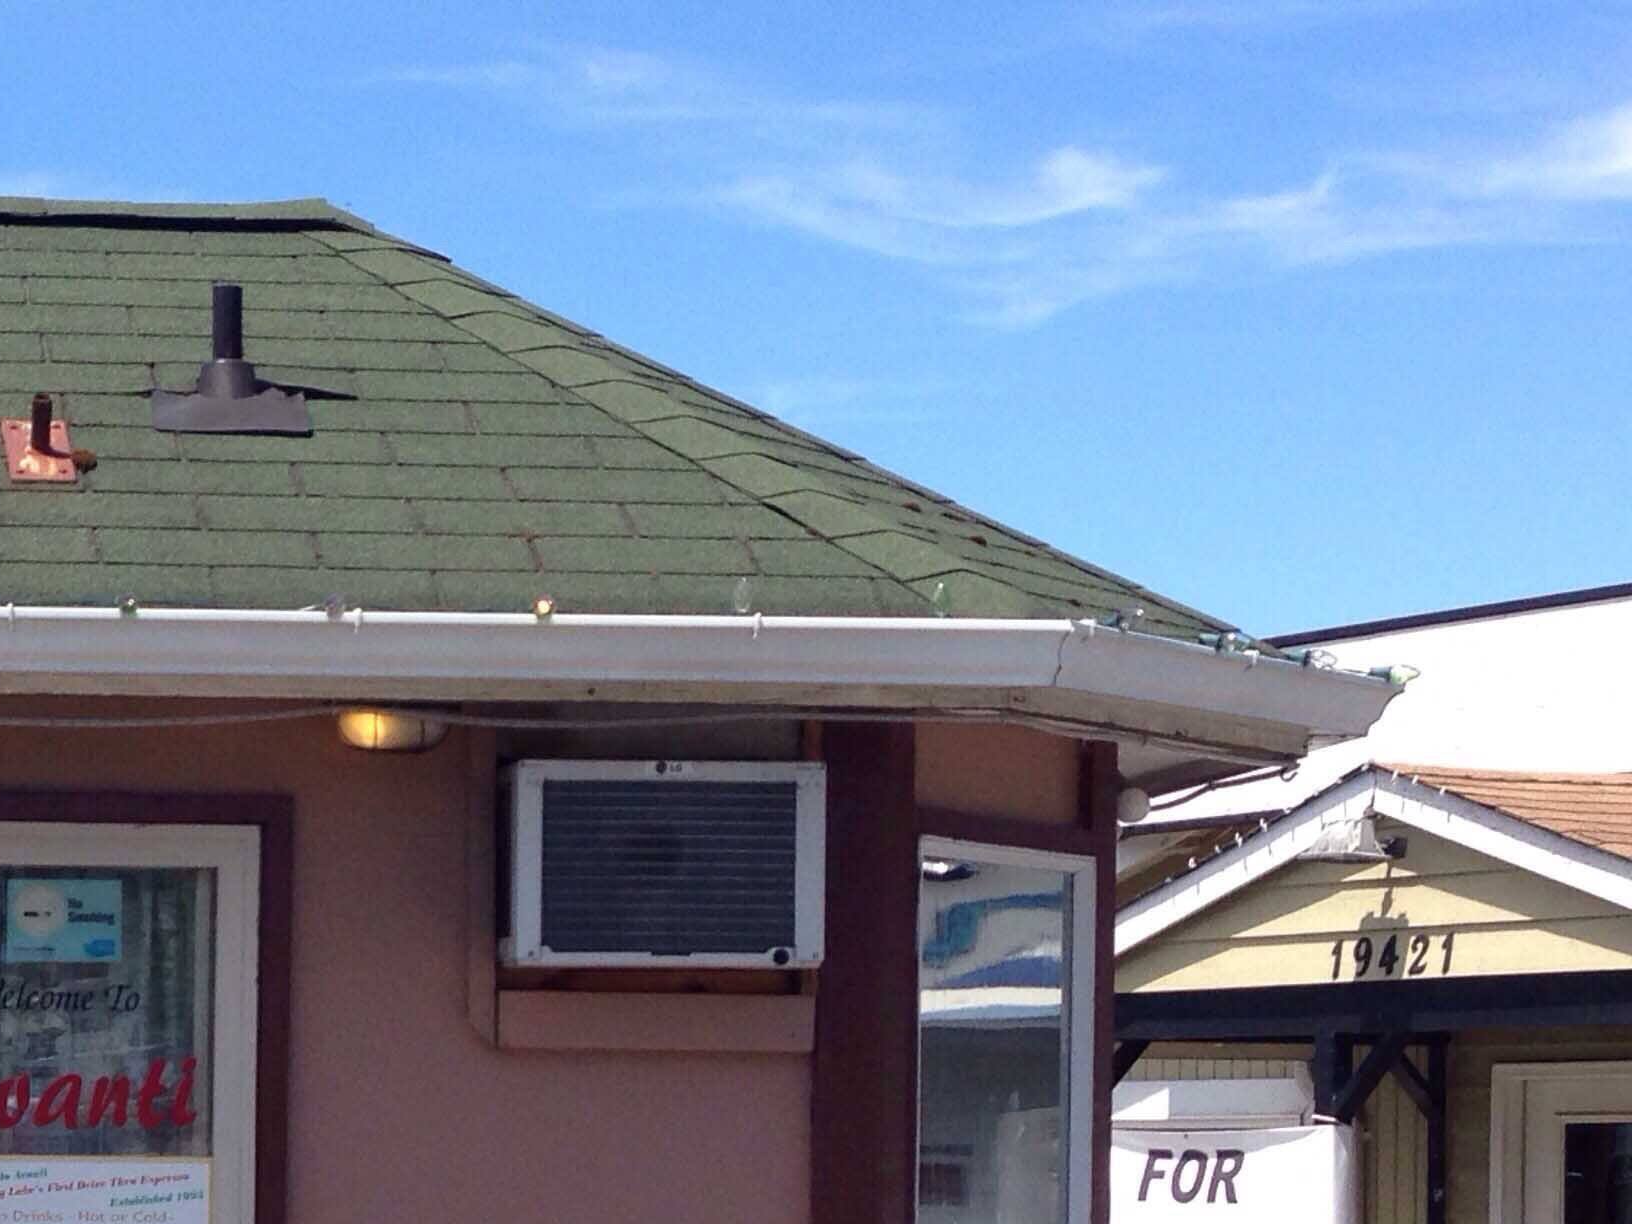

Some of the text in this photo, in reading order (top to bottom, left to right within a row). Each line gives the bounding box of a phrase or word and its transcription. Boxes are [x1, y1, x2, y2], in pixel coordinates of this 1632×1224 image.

[1331, 932, 1455, 978] 19421
[105, 982, 141, 1012] To
[1137, 1148, 1246, 1205] FOR
